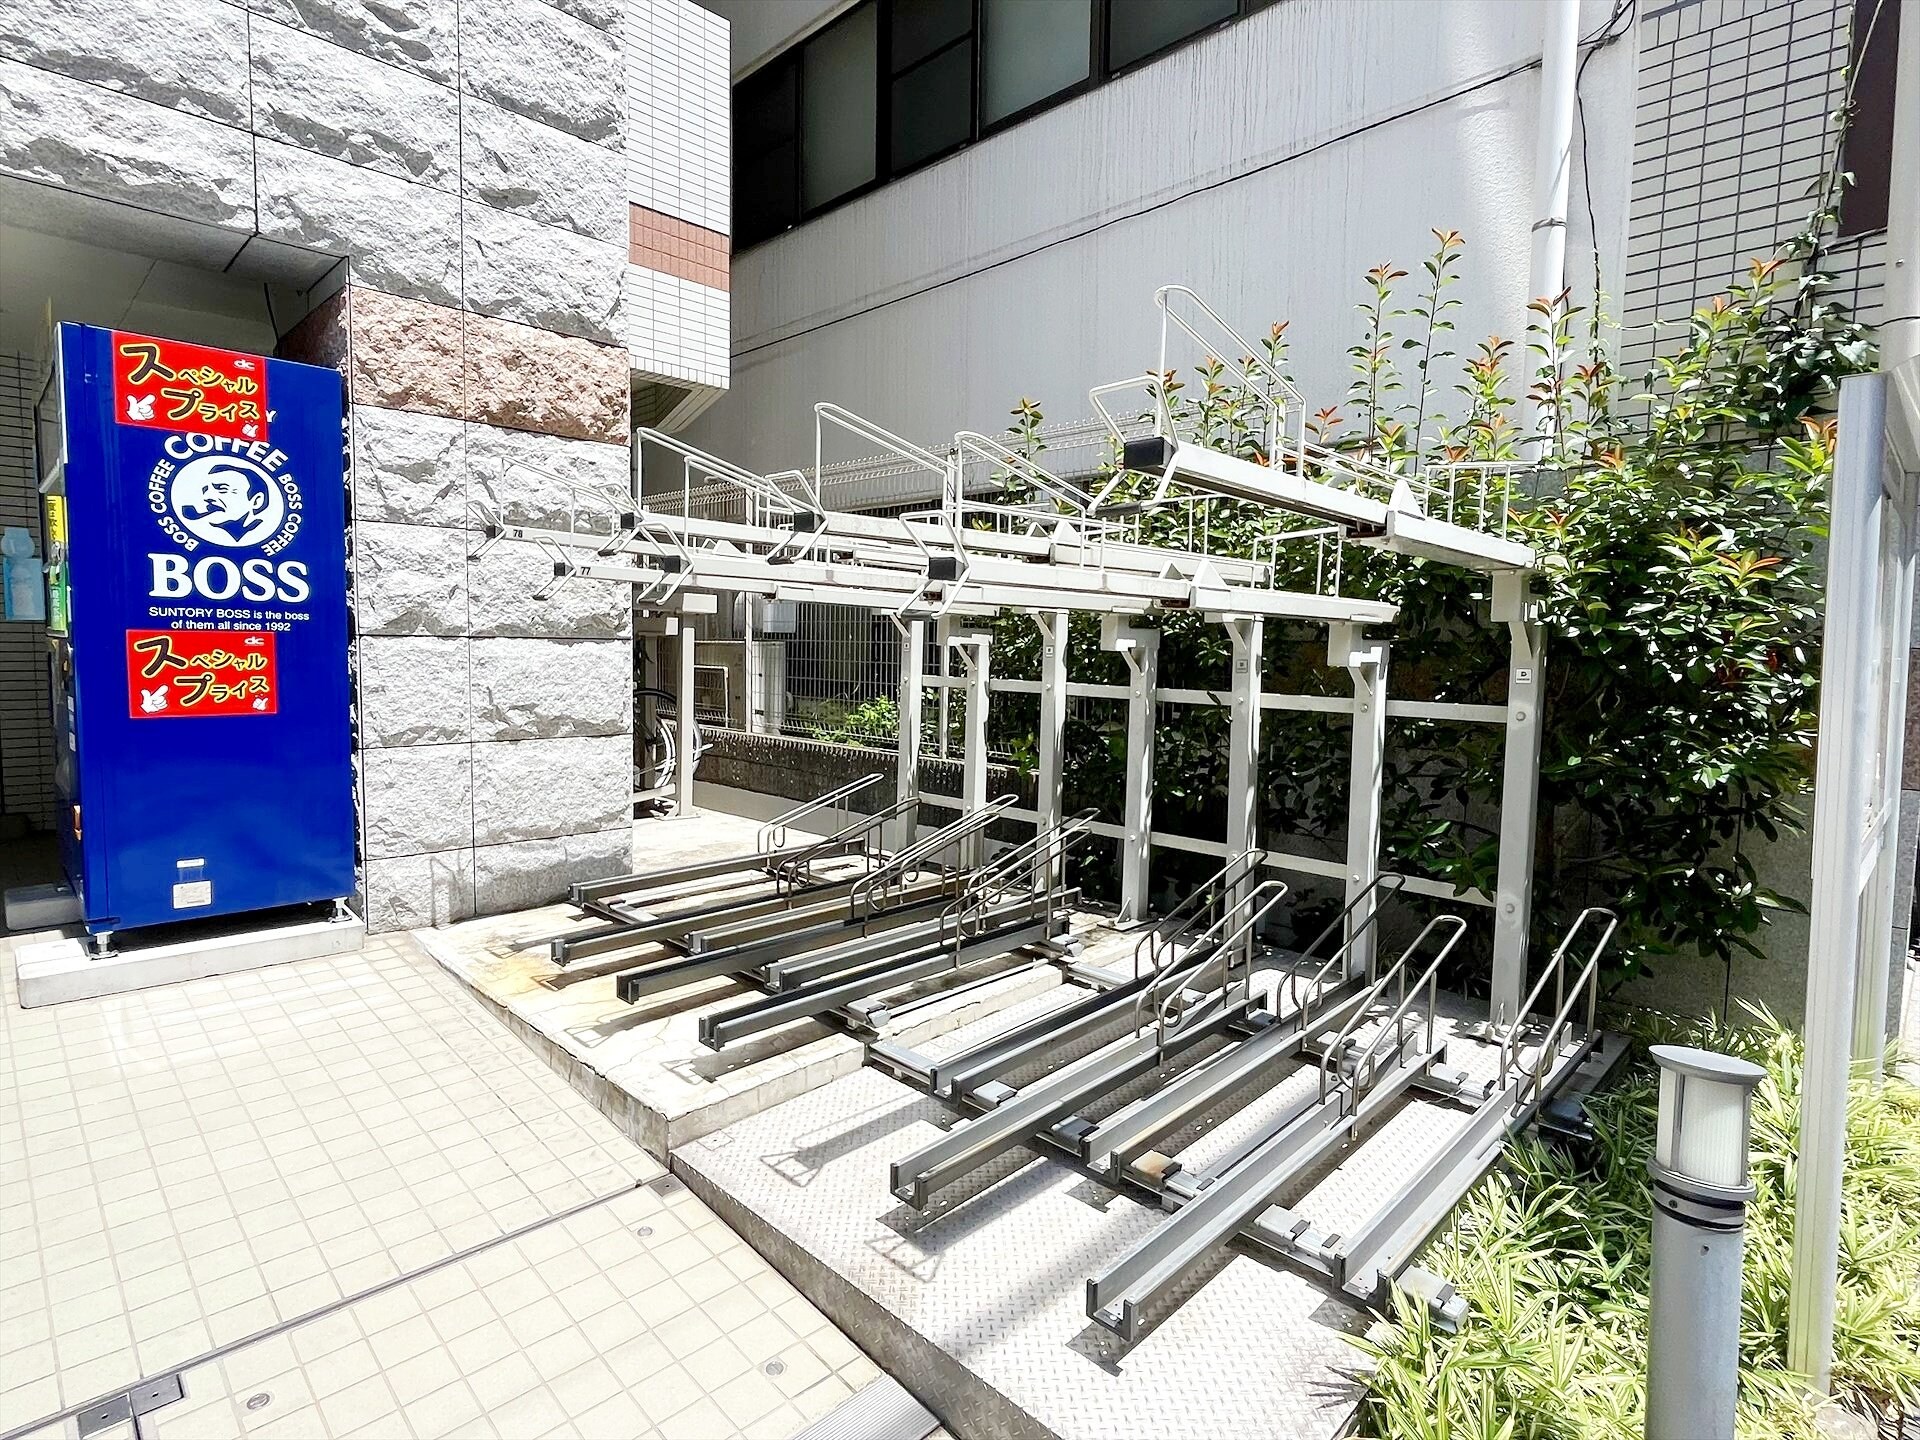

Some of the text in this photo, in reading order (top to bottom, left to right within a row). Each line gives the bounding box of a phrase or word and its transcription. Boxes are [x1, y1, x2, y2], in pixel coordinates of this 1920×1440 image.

[120, 343, 258, 395] スペシャル
[161, 387, 260, 422] プライス
[164, 432, 289, 472] COFFEE
[148, 458, 199, 552] BOSS COFFEE
[260, 473, 303, 557] BOSS COFFEE
[513, 529, 523, 538] 78
[147, 553, 310, 603] BOSS
[580, 566, 591, 575] 77
[149, 607, 309, 621] SUNTORY BOSS is the boss
[171, 620, 291, 631] of them all since 1992
[134, 635, 268, 678] スペシャル
[173, 672, 270, 707] プライス
